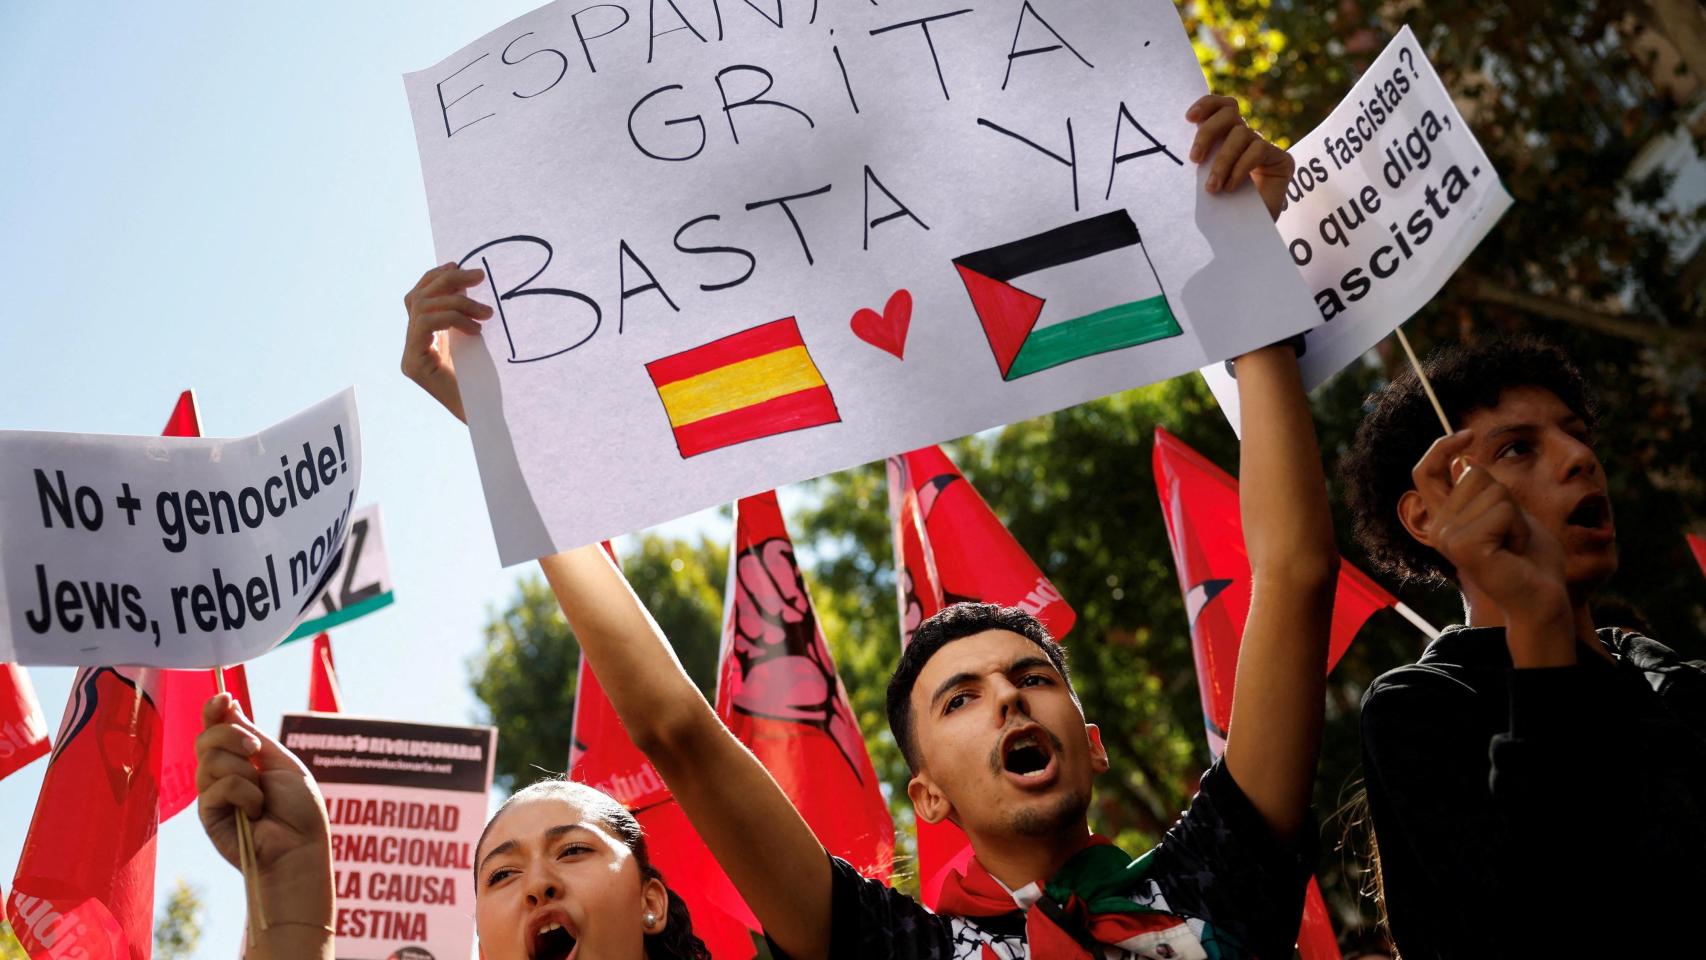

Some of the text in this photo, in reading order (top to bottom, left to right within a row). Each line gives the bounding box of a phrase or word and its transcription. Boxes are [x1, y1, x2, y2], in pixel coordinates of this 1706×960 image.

[436, 0, 878, 138] ESPAN
[1324, 47, 1419, 170] fascistas?
[458, 101, 1183, 363] BASTA YA
[1319, 185, 1381, 248] que
[1383, 109, 1451, 189] diga,
[34, 424, 347, 552] No + genocide!
[25, 564, 160, 647] Jews,
[170, 554, 281, 634] rebel
[336, 908, 427, 941] ESTINA
[368, 872, 456, 905] CAUSA
